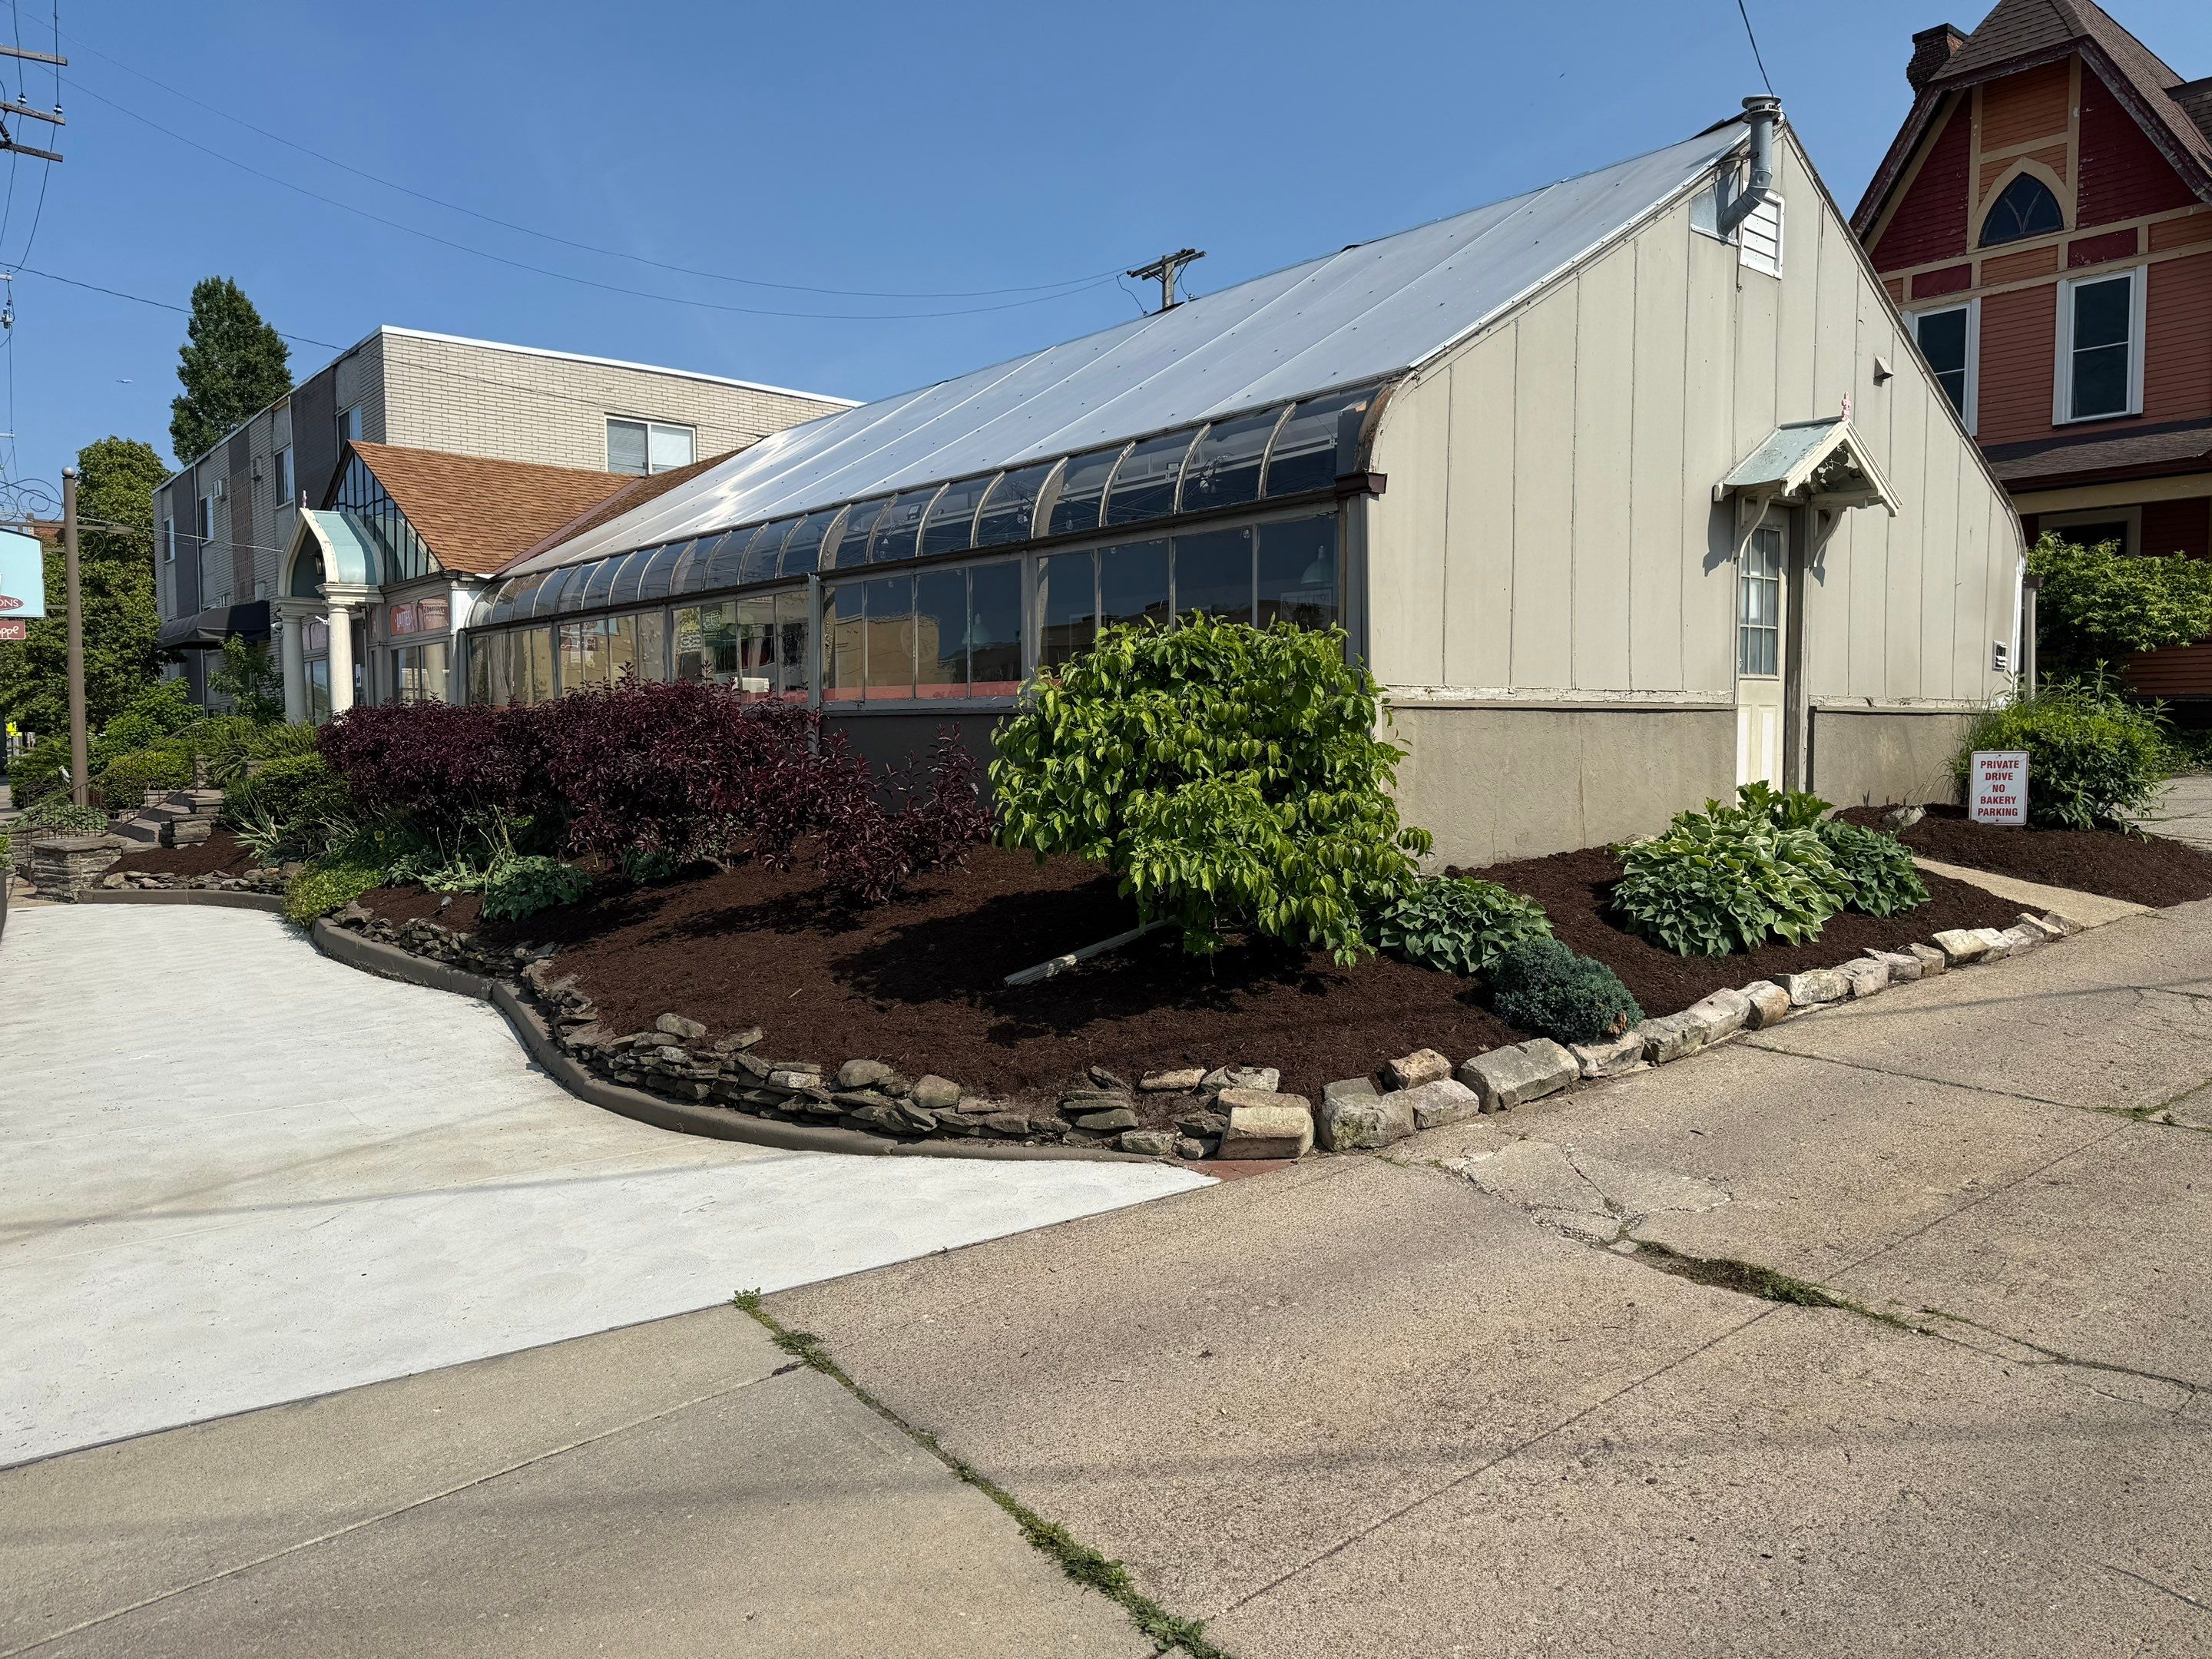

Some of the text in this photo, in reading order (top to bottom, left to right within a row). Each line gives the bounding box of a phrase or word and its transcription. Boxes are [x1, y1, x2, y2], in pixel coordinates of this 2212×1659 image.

[0, 625, 19, 638] ppe
[1980, 760, 2020, 769] PRIVATE
[1985, 772, 2014, 781] DRIVE
[1992, 784, 2005, 793] NO
[1980, 796, 2017, 805] BAKERY
[1978, 808, 2018, 816] PARKING
